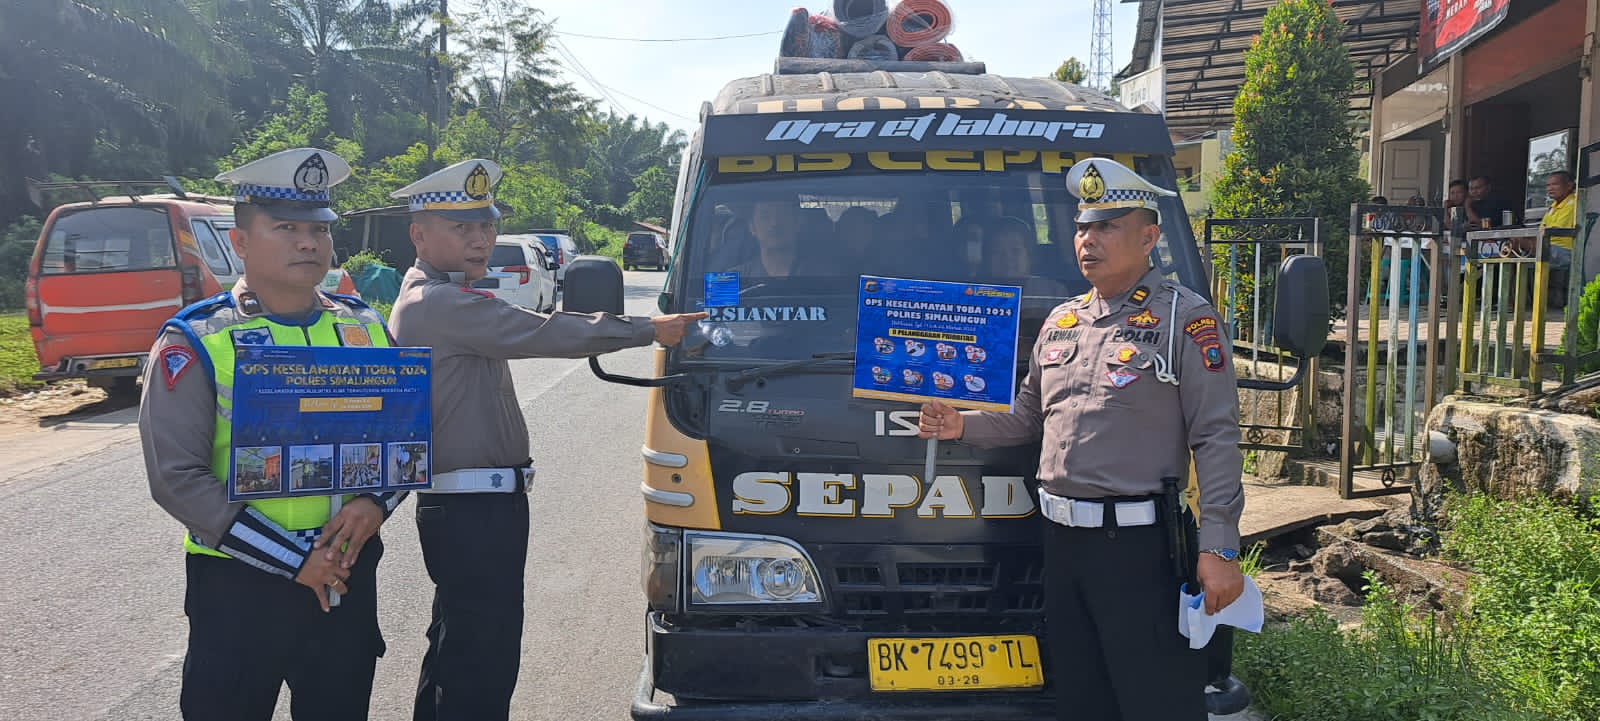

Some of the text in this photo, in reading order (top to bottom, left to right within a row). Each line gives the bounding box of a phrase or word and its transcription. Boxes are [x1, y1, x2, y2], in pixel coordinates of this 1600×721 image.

[765, 113, 1105, 144] Ora et labora
[703, 307, 827, 321] P.SIANTAR
[865, 298, 1012, 316] OPS KESELAMATAN TOBA 2024
[887, 310, 987, 325] POLRES SIMALUNGUN
[1113, 329, 1160, 345] POLRI
[272, 365, 362, 375] KESELAMATAN
[364, 365, 396, 375] TOBA
[400, 366, 427, 376] 2024
[285, 376, 397, 385] POLRES SIMALUNGUN
[718, 400, 769, 413] 2.8
[874, 410, 922, 437] IS
[877, 640, 1033, 671] BK 7499 TL
